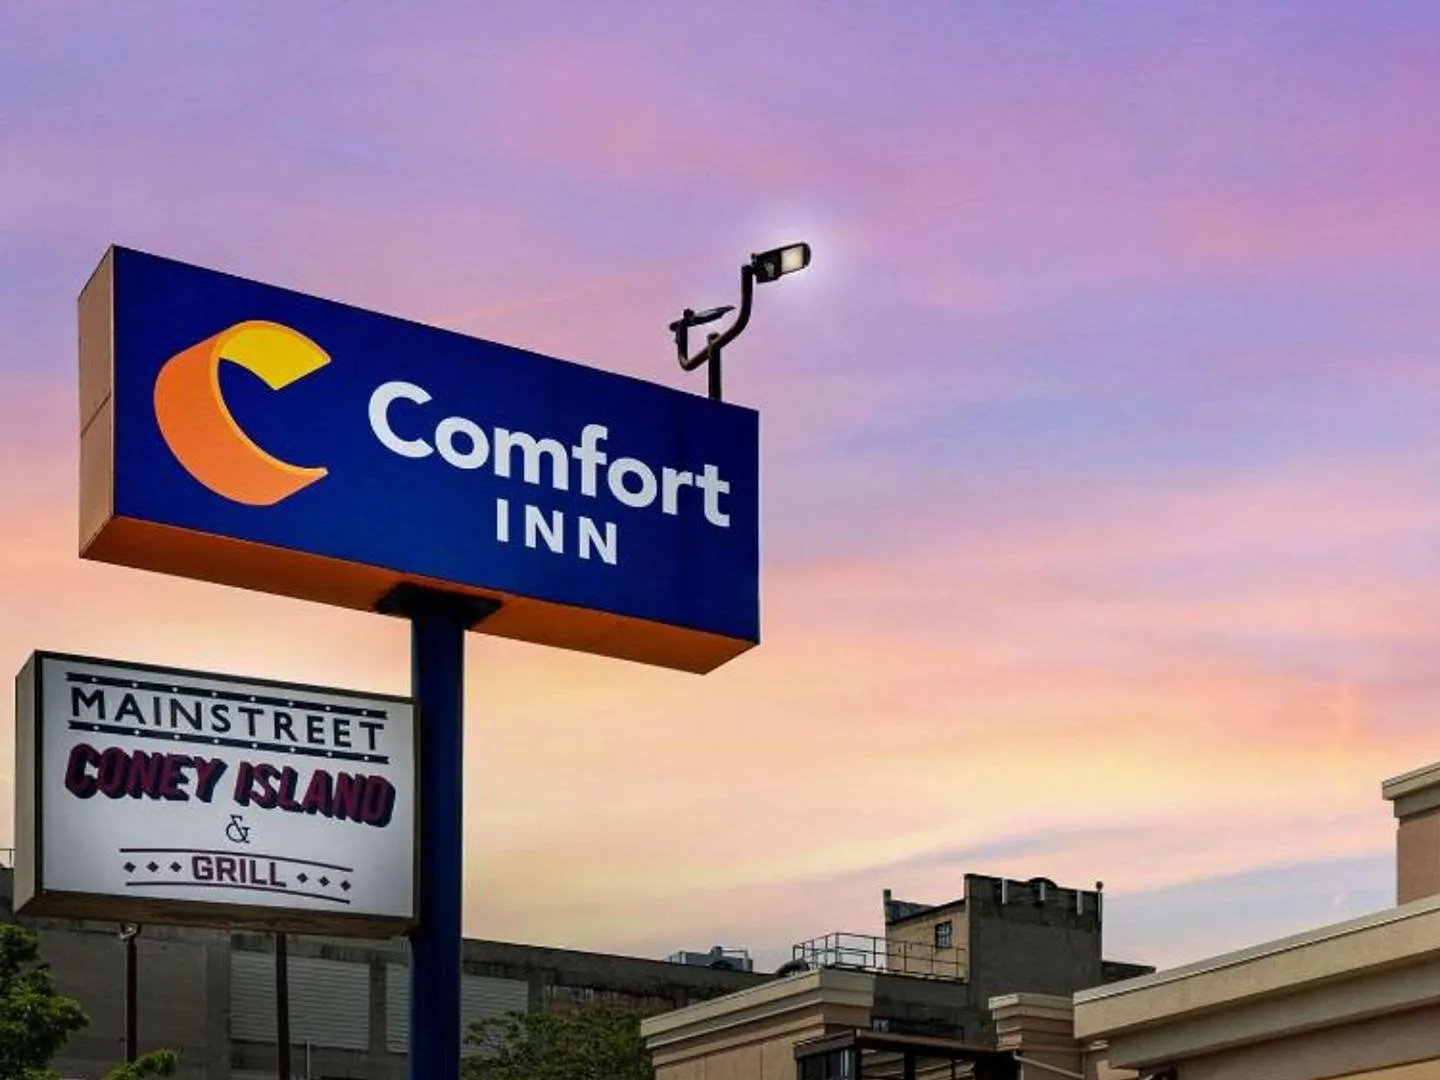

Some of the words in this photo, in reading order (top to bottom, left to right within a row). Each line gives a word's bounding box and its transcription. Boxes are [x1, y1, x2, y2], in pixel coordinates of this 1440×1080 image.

[368, 378, 730, 528] Comfort
[496, 498, 617, 565] INN
[71, 686, 385, 751] MAINSTREET
[65, 743, 228, 803] CONEY
[234, 760, 396, 828] ISLAND
[226, 814, 250, 844] &
[191, 855, 287, 888] GRILL
